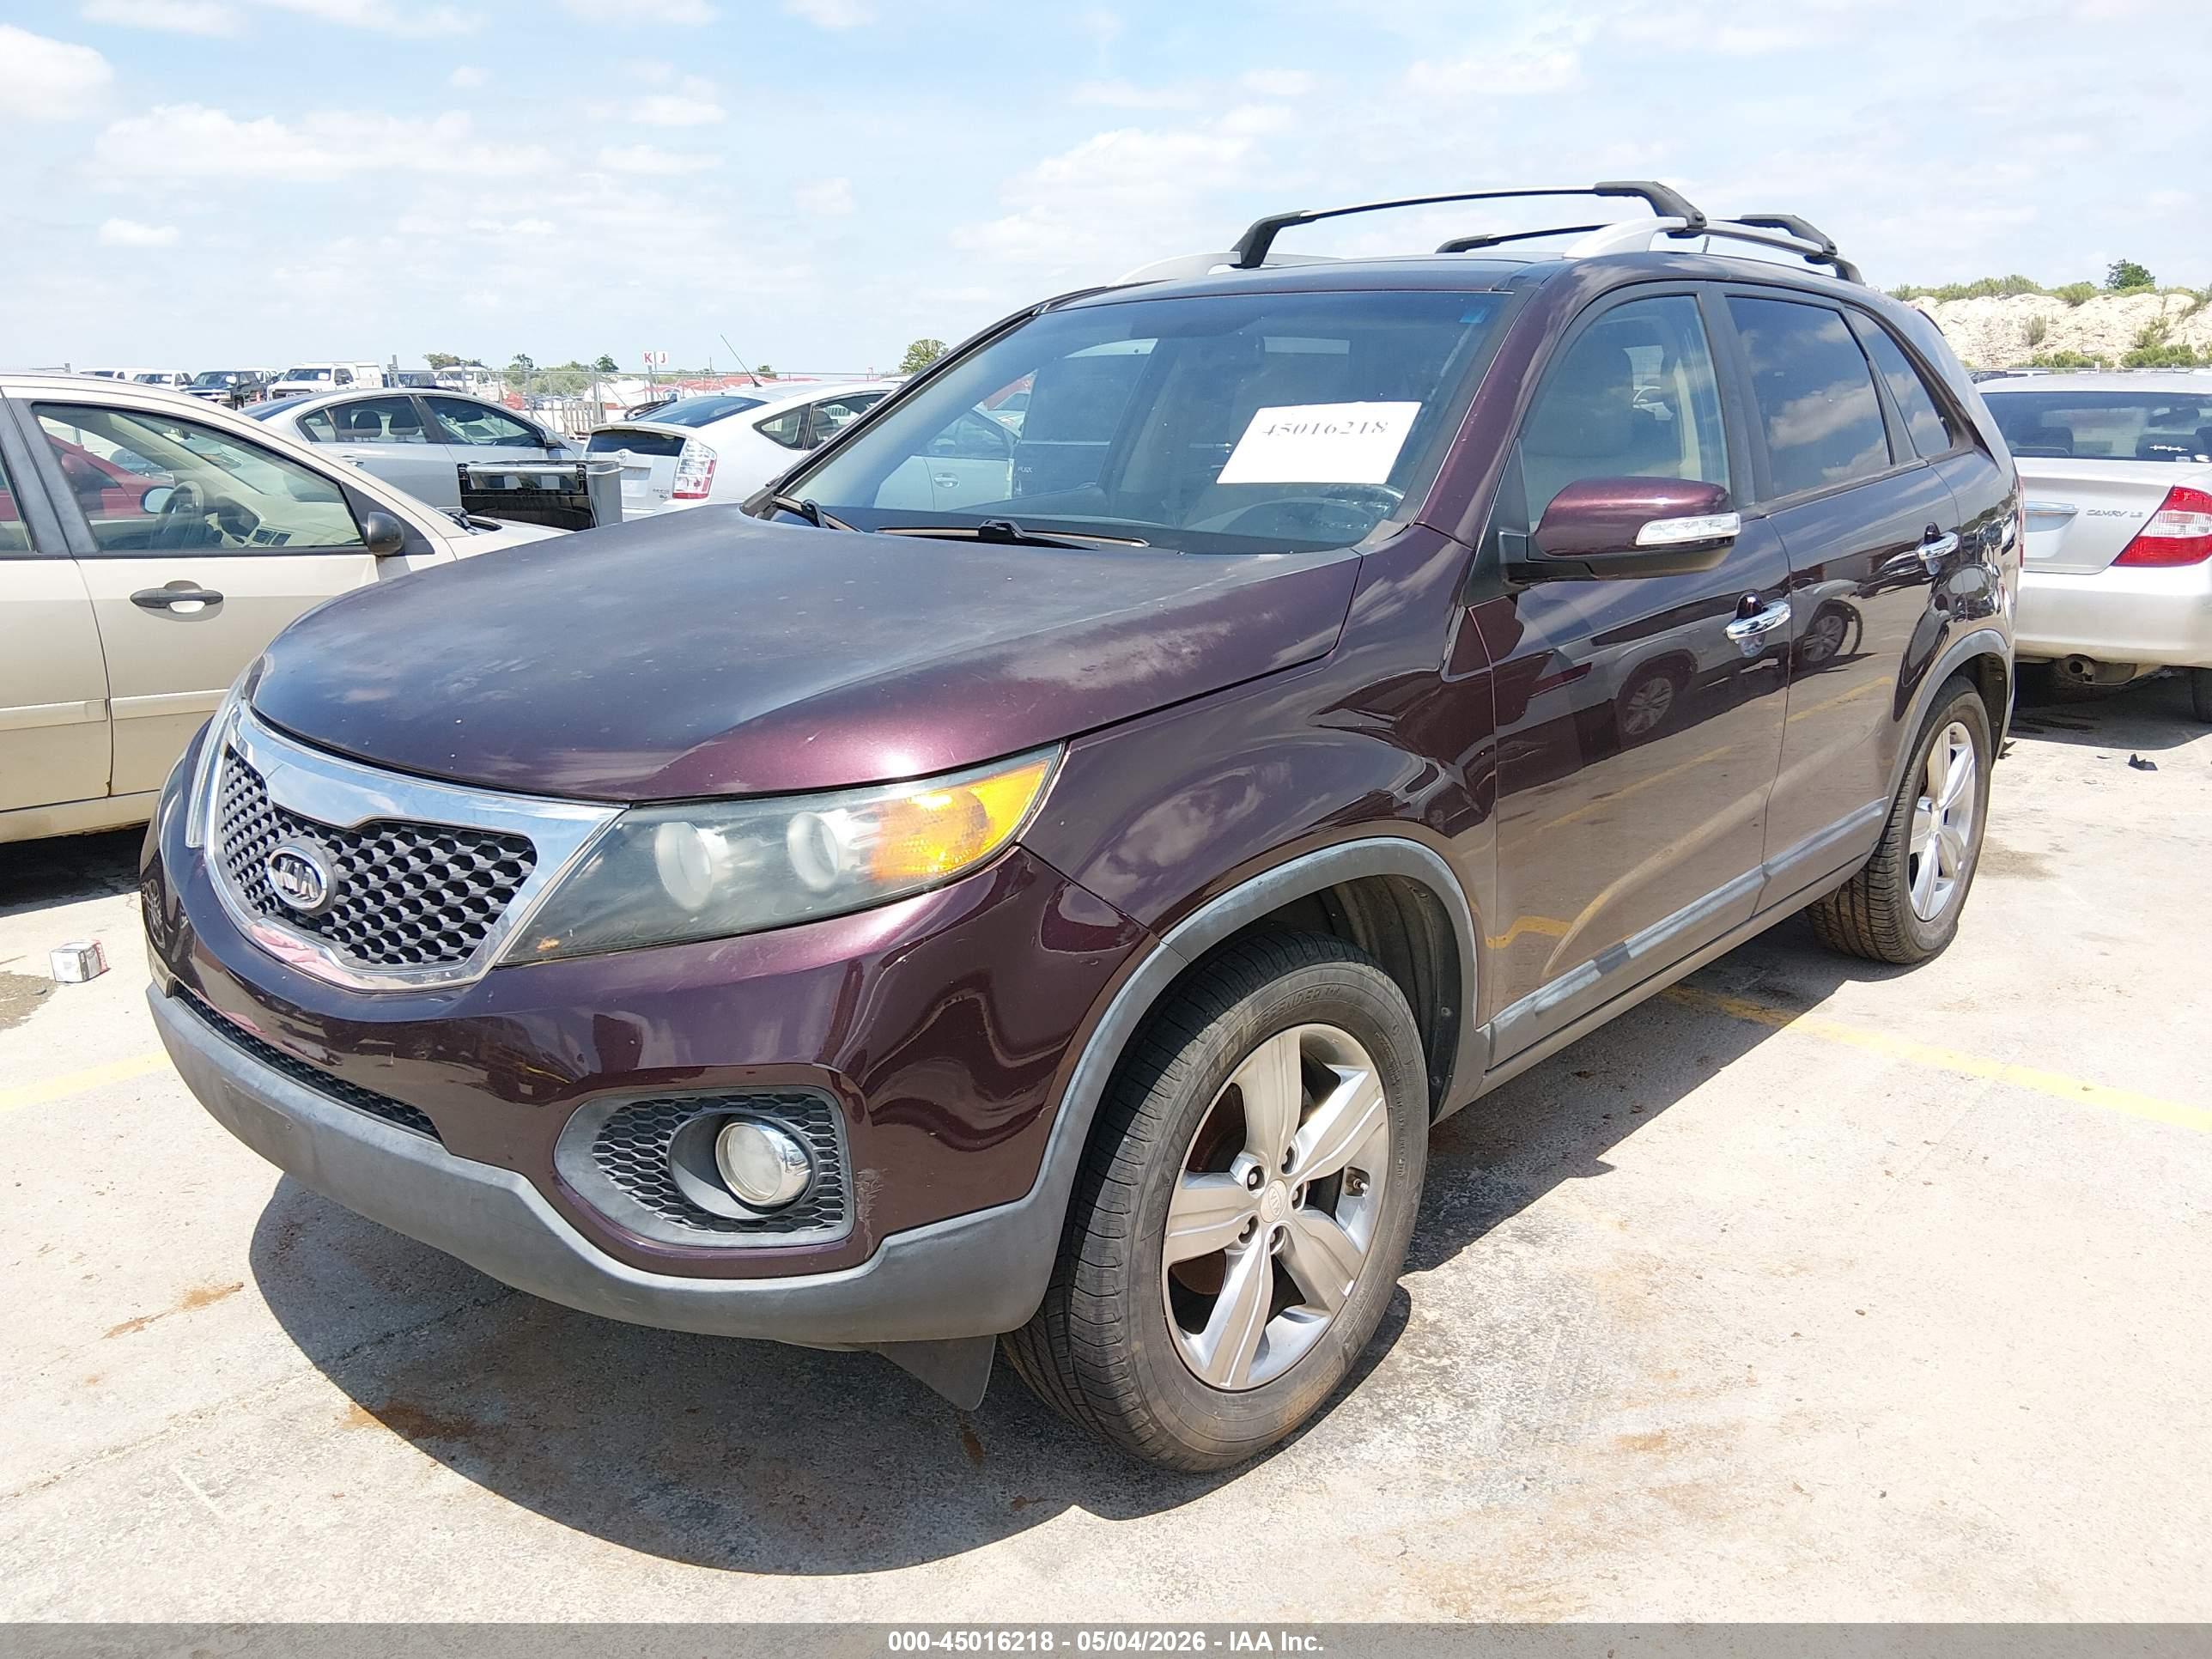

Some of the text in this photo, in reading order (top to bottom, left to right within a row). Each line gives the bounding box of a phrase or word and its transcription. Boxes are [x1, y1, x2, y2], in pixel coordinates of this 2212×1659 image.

[644, 353, 653, 363] K
[660, 353, 666, 363] J
[1261, 421, 1389, 436] 45016218
